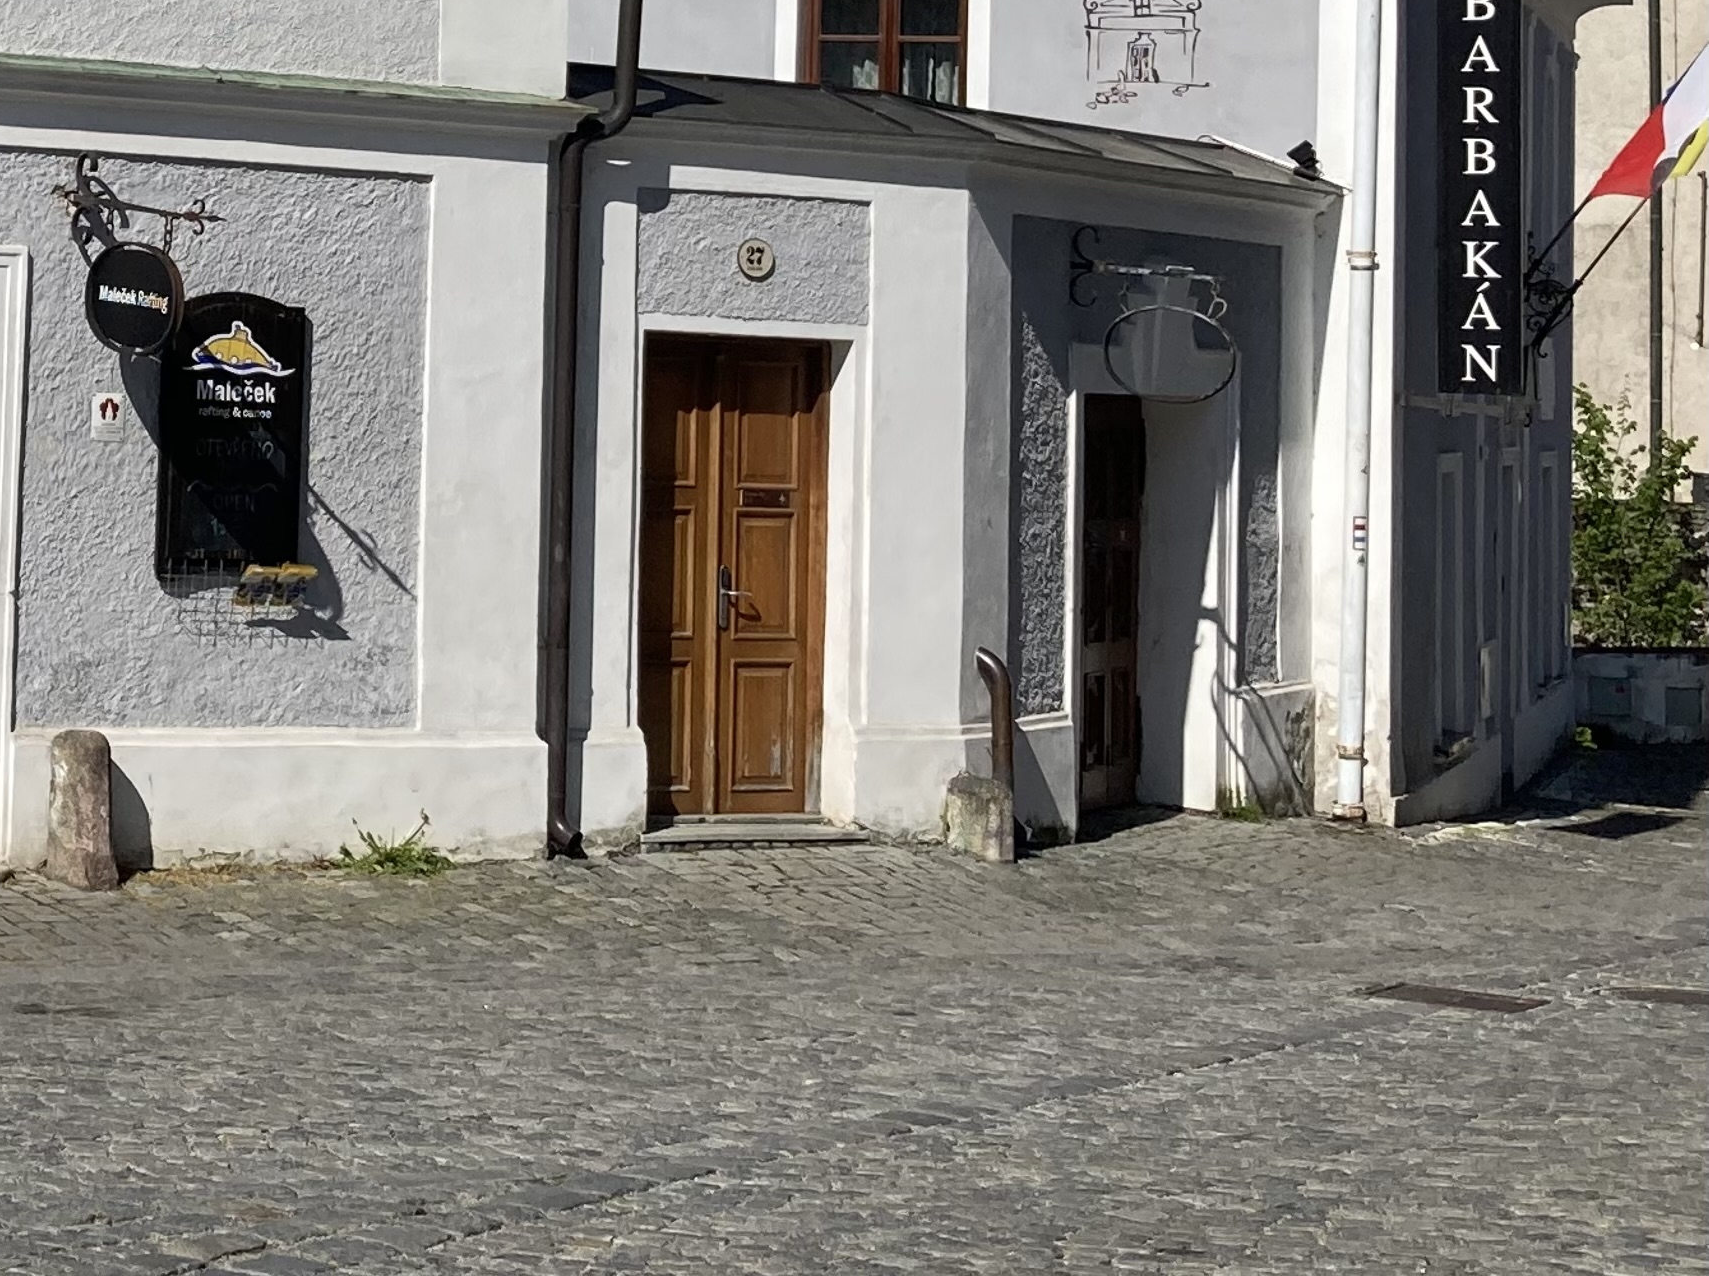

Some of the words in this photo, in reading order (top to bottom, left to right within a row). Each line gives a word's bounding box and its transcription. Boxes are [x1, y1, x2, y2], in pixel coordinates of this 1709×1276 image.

[746, 245, 765, 266] 27
[196, 379, 276, 404] Maleček
[232, 405, 242, 418] &
